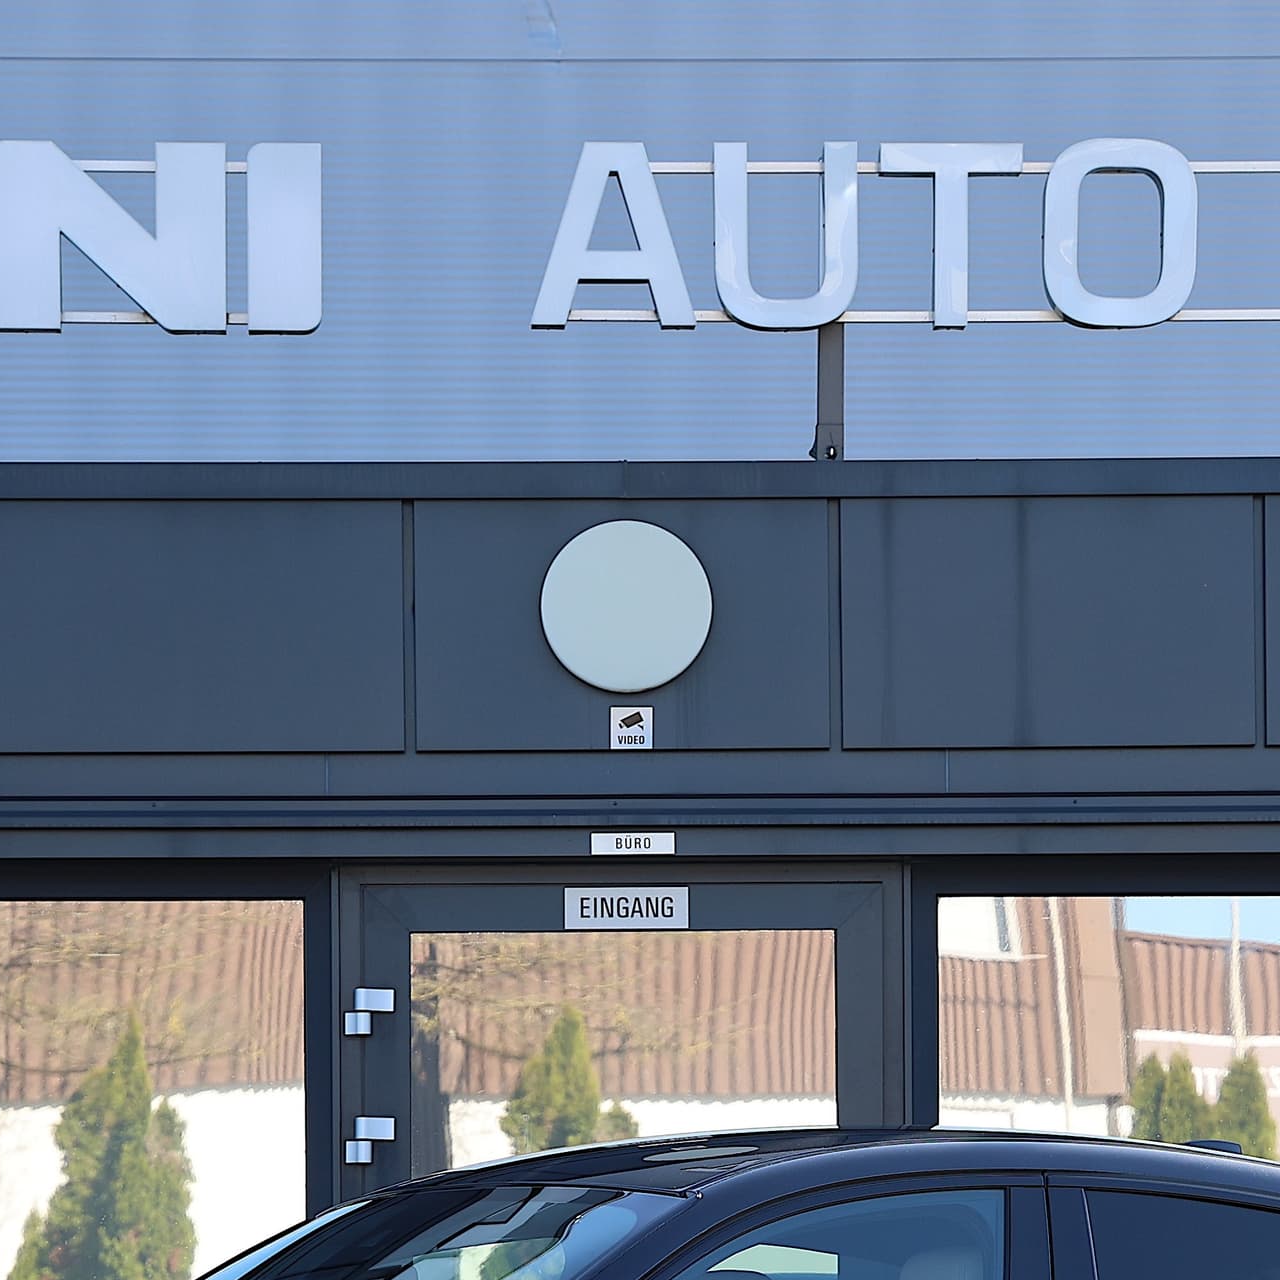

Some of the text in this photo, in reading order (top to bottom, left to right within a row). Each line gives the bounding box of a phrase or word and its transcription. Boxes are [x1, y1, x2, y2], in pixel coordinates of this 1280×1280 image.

[528, 137, 1199, 331] AUTO
[617, 735, 645, 745] VIDEO
[615, 834, 652, 850] BÜRO
[580, 896, 674, 919] EINGANG
